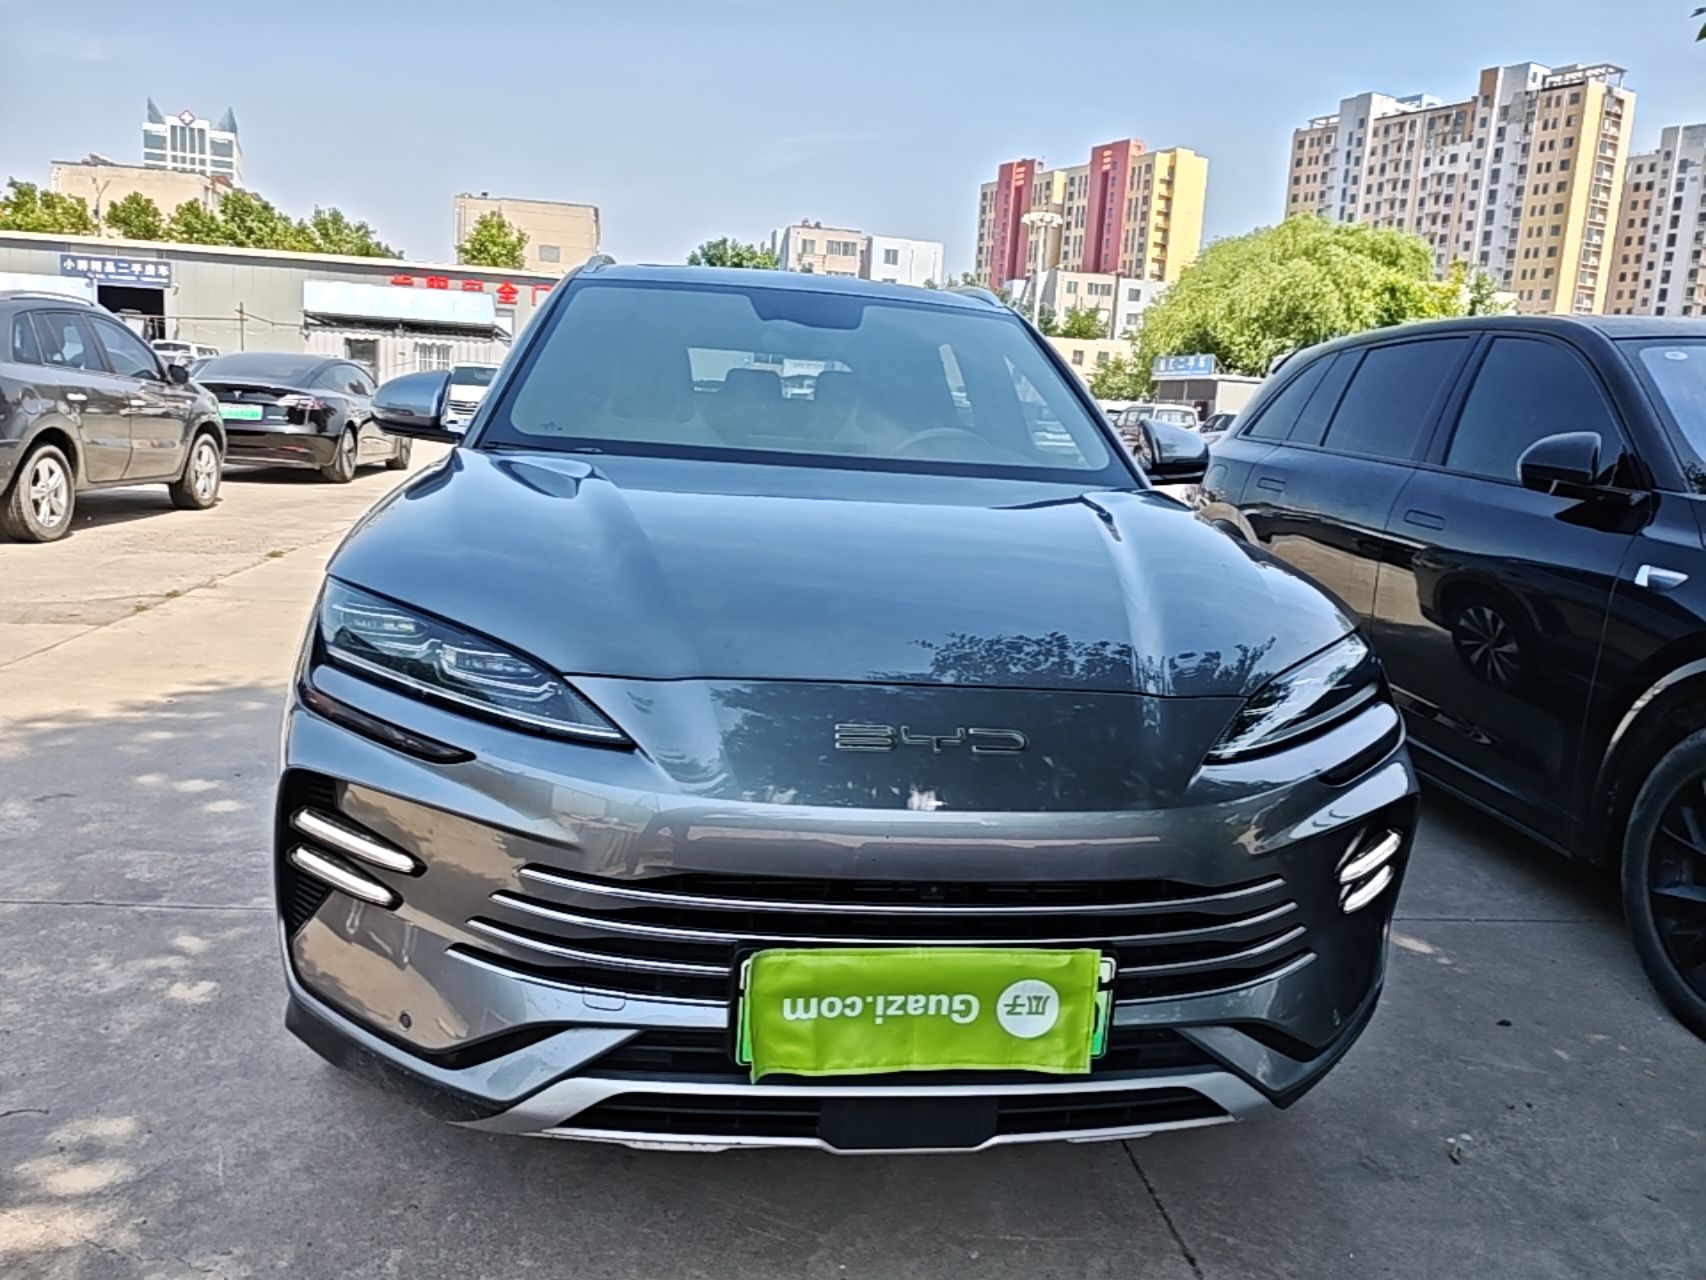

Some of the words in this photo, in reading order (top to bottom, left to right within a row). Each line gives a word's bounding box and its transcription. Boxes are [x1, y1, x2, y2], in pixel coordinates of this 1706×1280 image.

[835, 723, 1029, 753] BYD
[782, 993, 980, 1025] Guazi.com
[1003, 993, 1051, 1017] 瓜子
